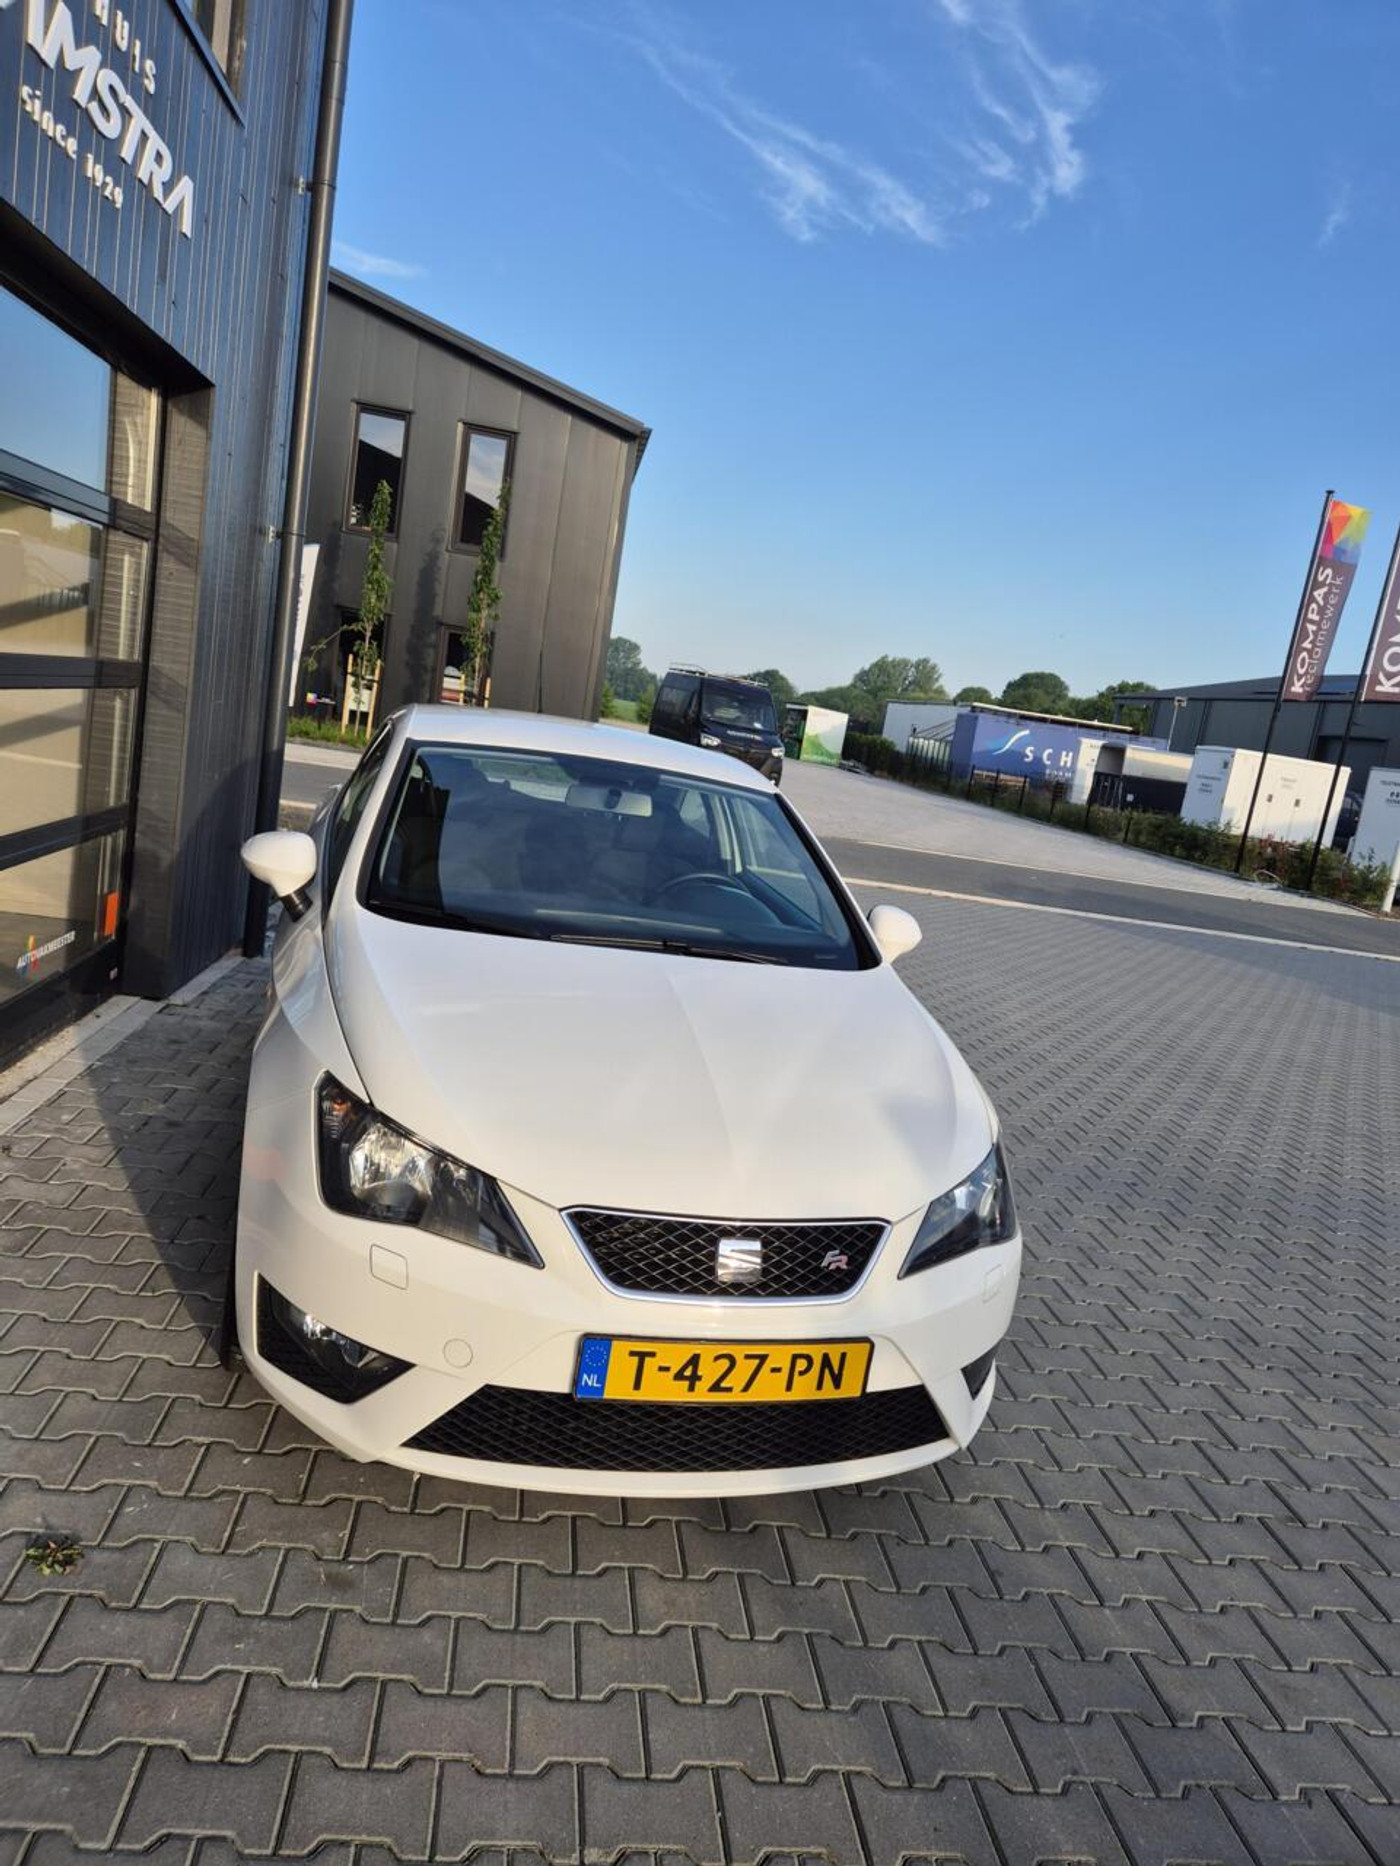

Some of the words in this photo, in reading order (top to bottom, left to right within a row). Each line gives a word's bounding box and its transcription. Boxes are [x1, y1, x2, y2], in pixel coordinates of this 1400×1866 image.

[21, 85, 78, 159] Since
[1291, 566, 1334, 694] KOMPAS
[1303, 574, 1344, 692] reclamewerk
[581, 1373, 601, 1387] NL
[628, 1350, 847, 1392] T-427-PN
